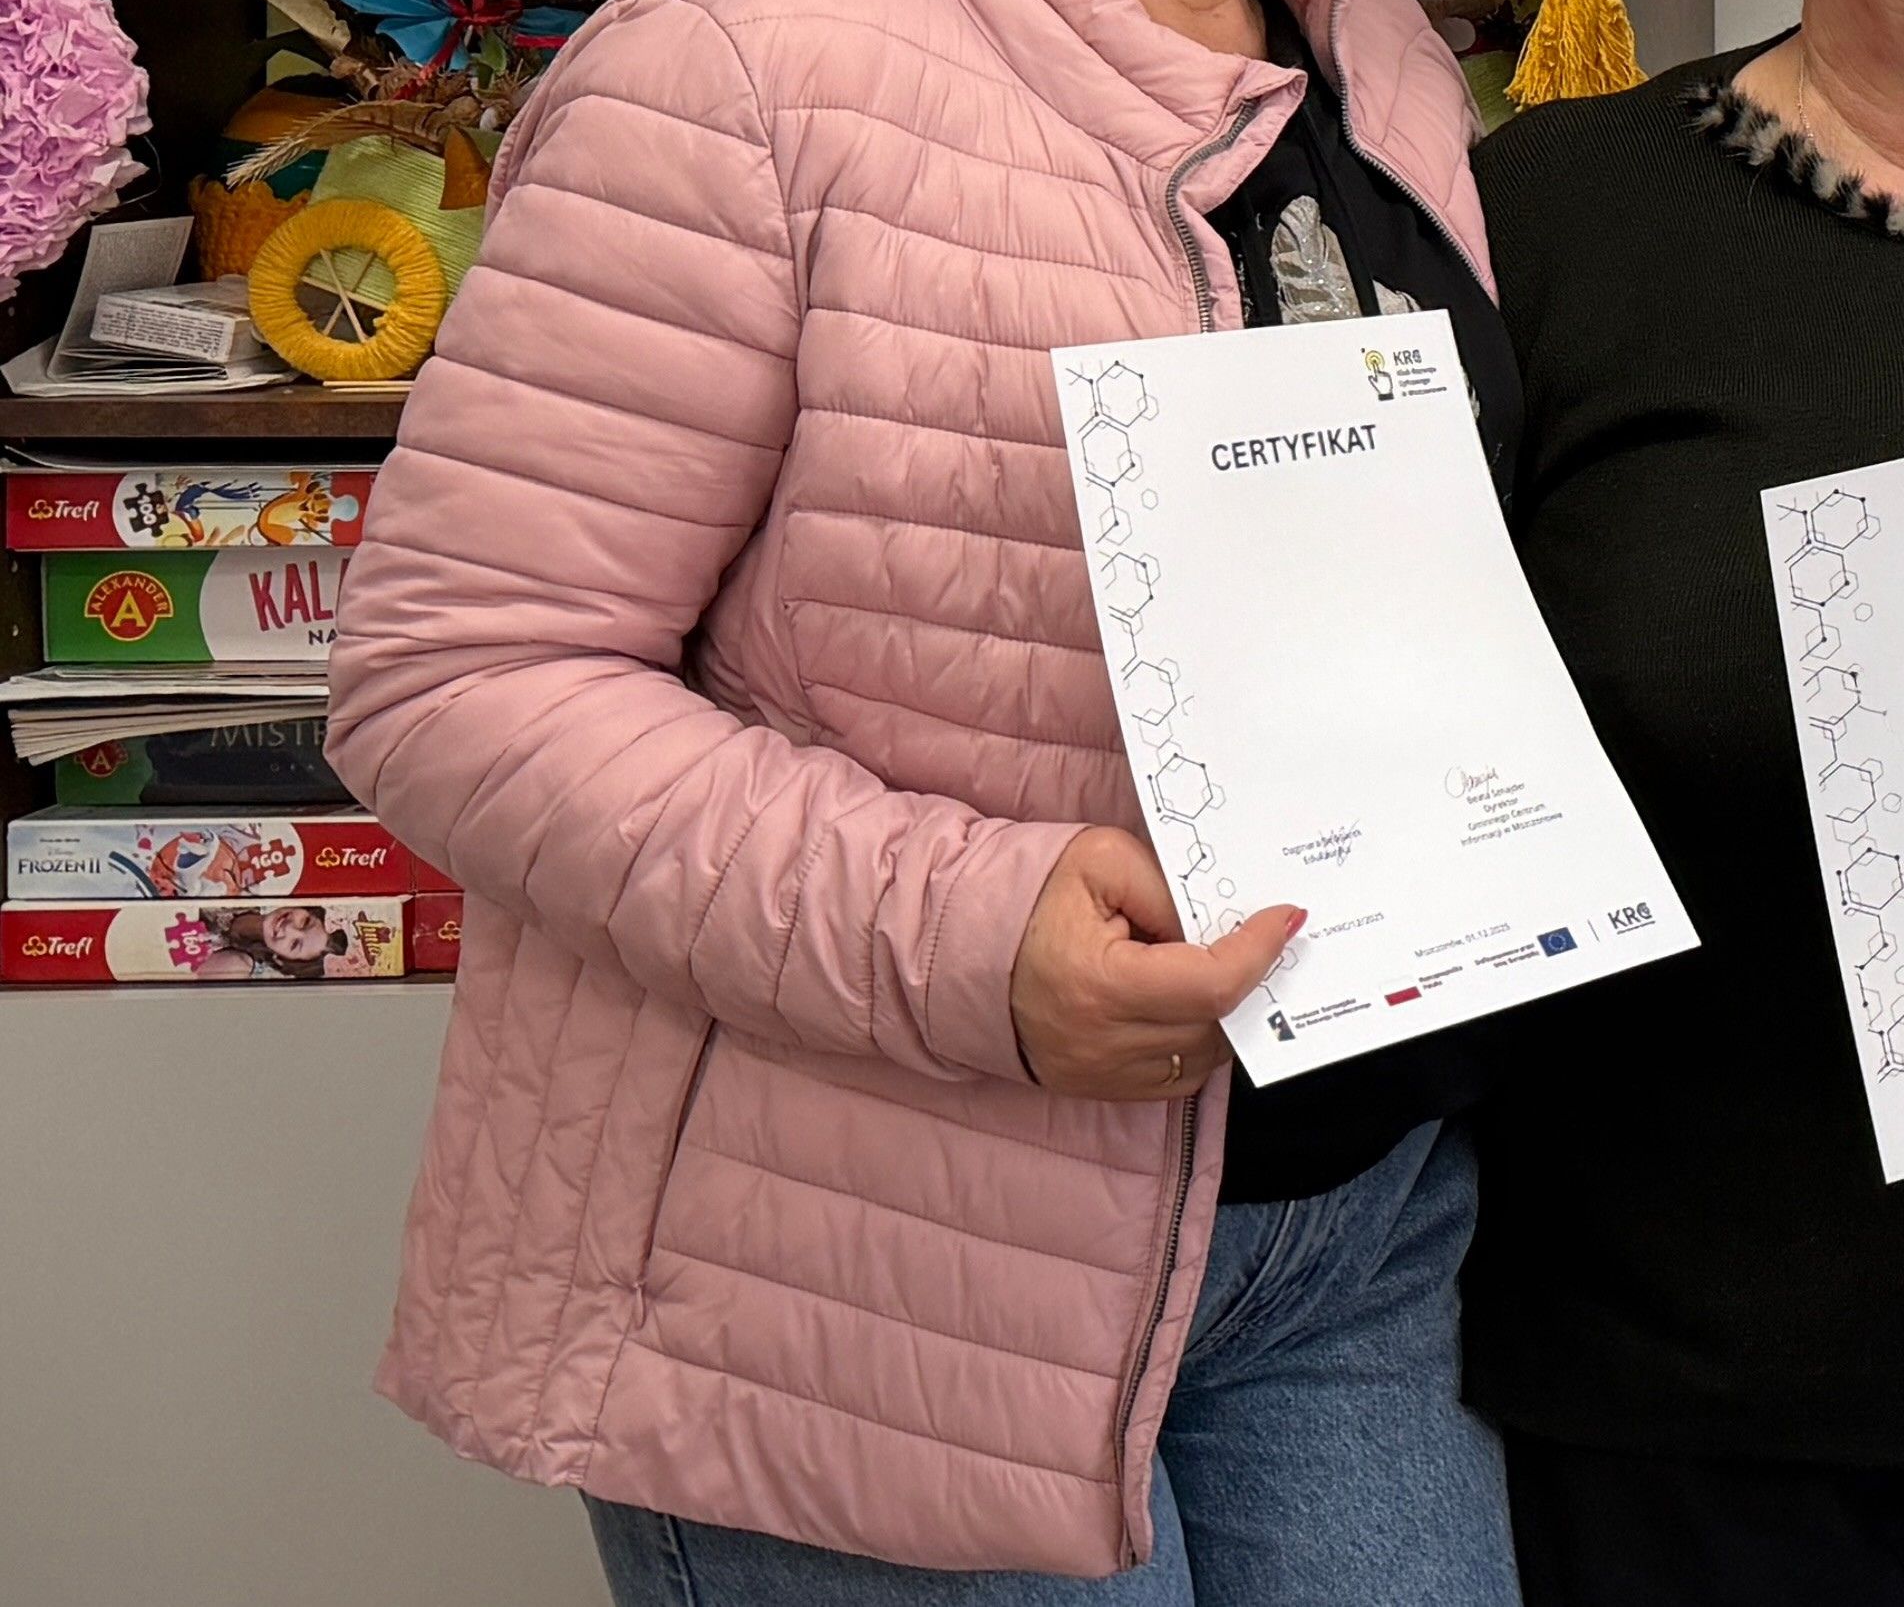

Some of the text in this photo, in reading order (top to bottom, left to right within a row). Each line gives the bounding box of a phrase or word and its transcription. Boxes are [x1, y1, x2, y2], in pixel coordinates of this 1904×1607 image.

[1211, 424, 1376, 471] CERTYFIKAT
[54, 499, 99, 521] Trefl
[138, 497, 157, 525] 100
[91, 576, 168, 612] ALEXANDER
[249, 557, 349, 632] KAL
[110, 589, 147, 628] A
[18, 858, 101, 874] FROZEN II
[251, 849, 284, 870] 160
[340, 848, 388, 867] Trefl
[48, 937, 94, 955] Trefl
[182, 929, 201, 955] 160
